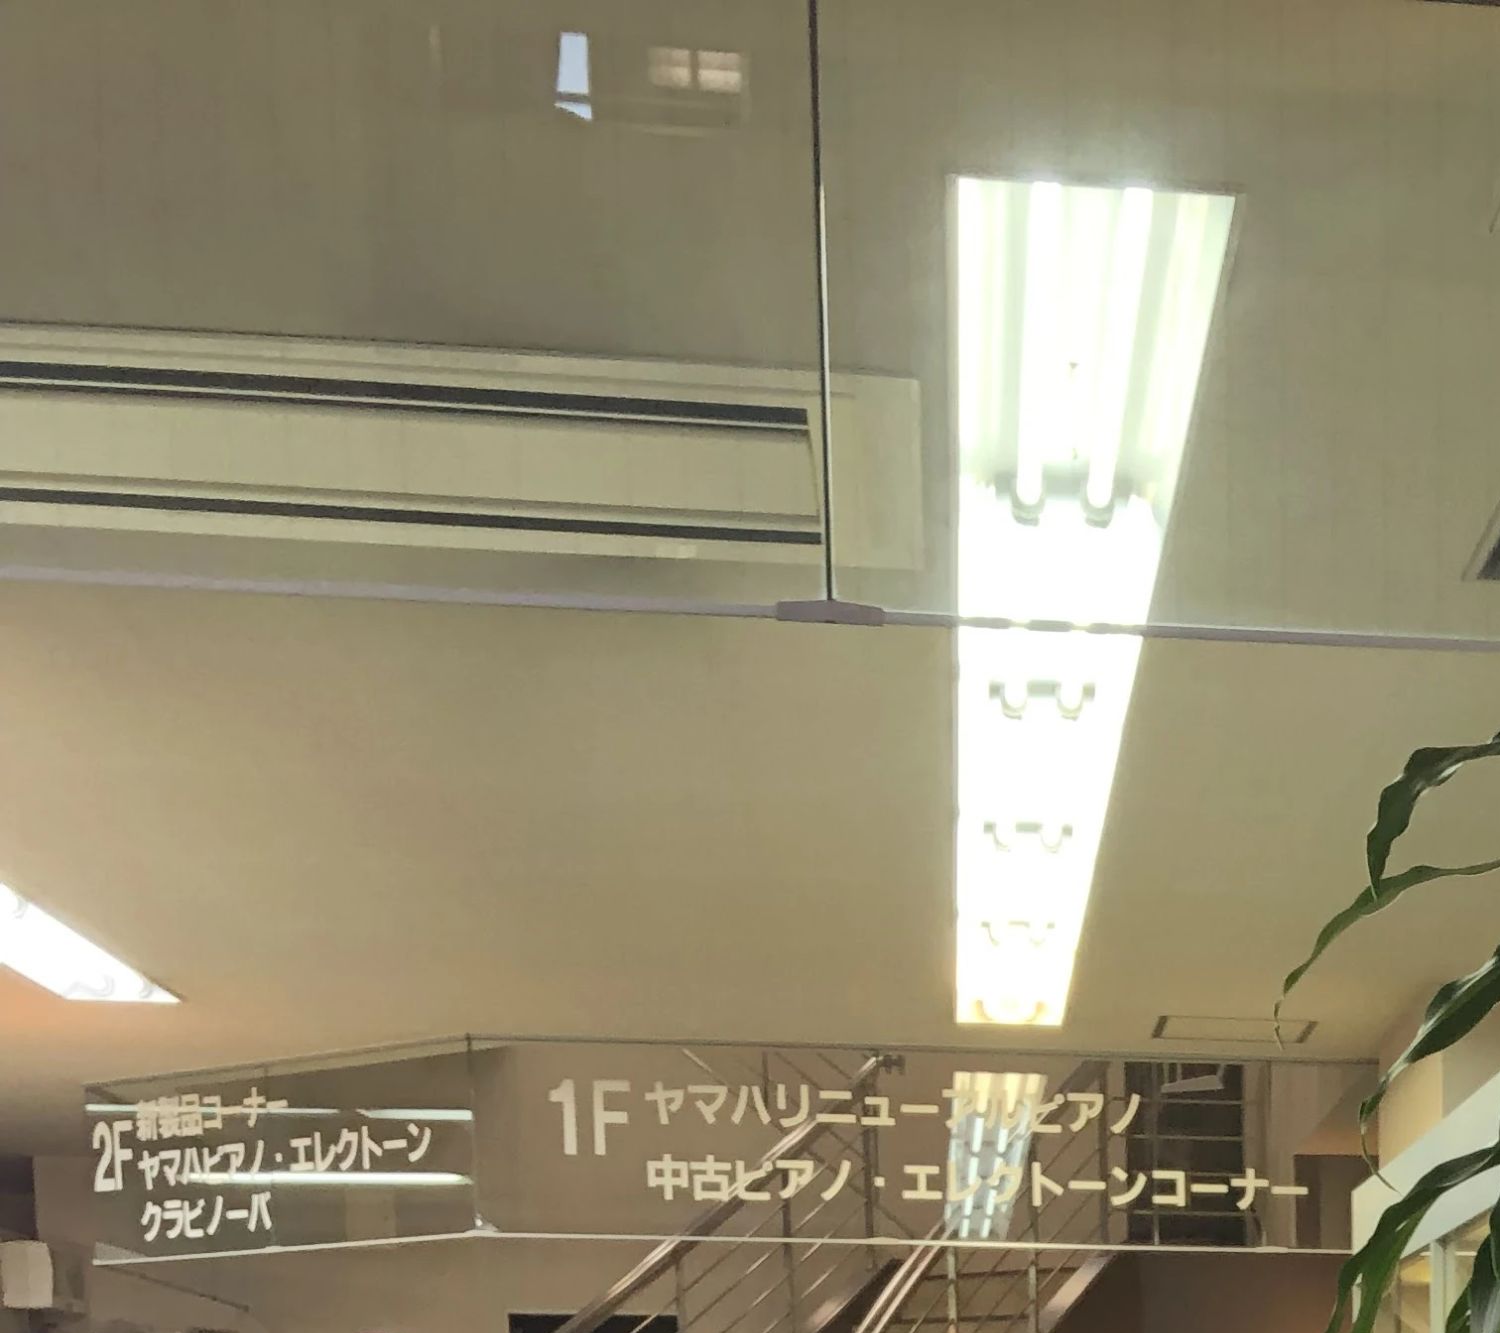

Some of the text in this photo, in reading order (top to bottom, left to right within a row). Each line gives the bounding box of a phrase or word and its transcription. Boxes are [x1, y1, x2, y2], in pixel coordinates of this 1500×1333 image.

[549, 1079, 631, 1155] 1F
[645, 1081, 1141, 1134] ヤマハリニューアルピアノ
[93, 1120, 134, 1192] 2F
[646, 1154, 1309, 1210] 中古ピアノ・エレクトーンコーナー
